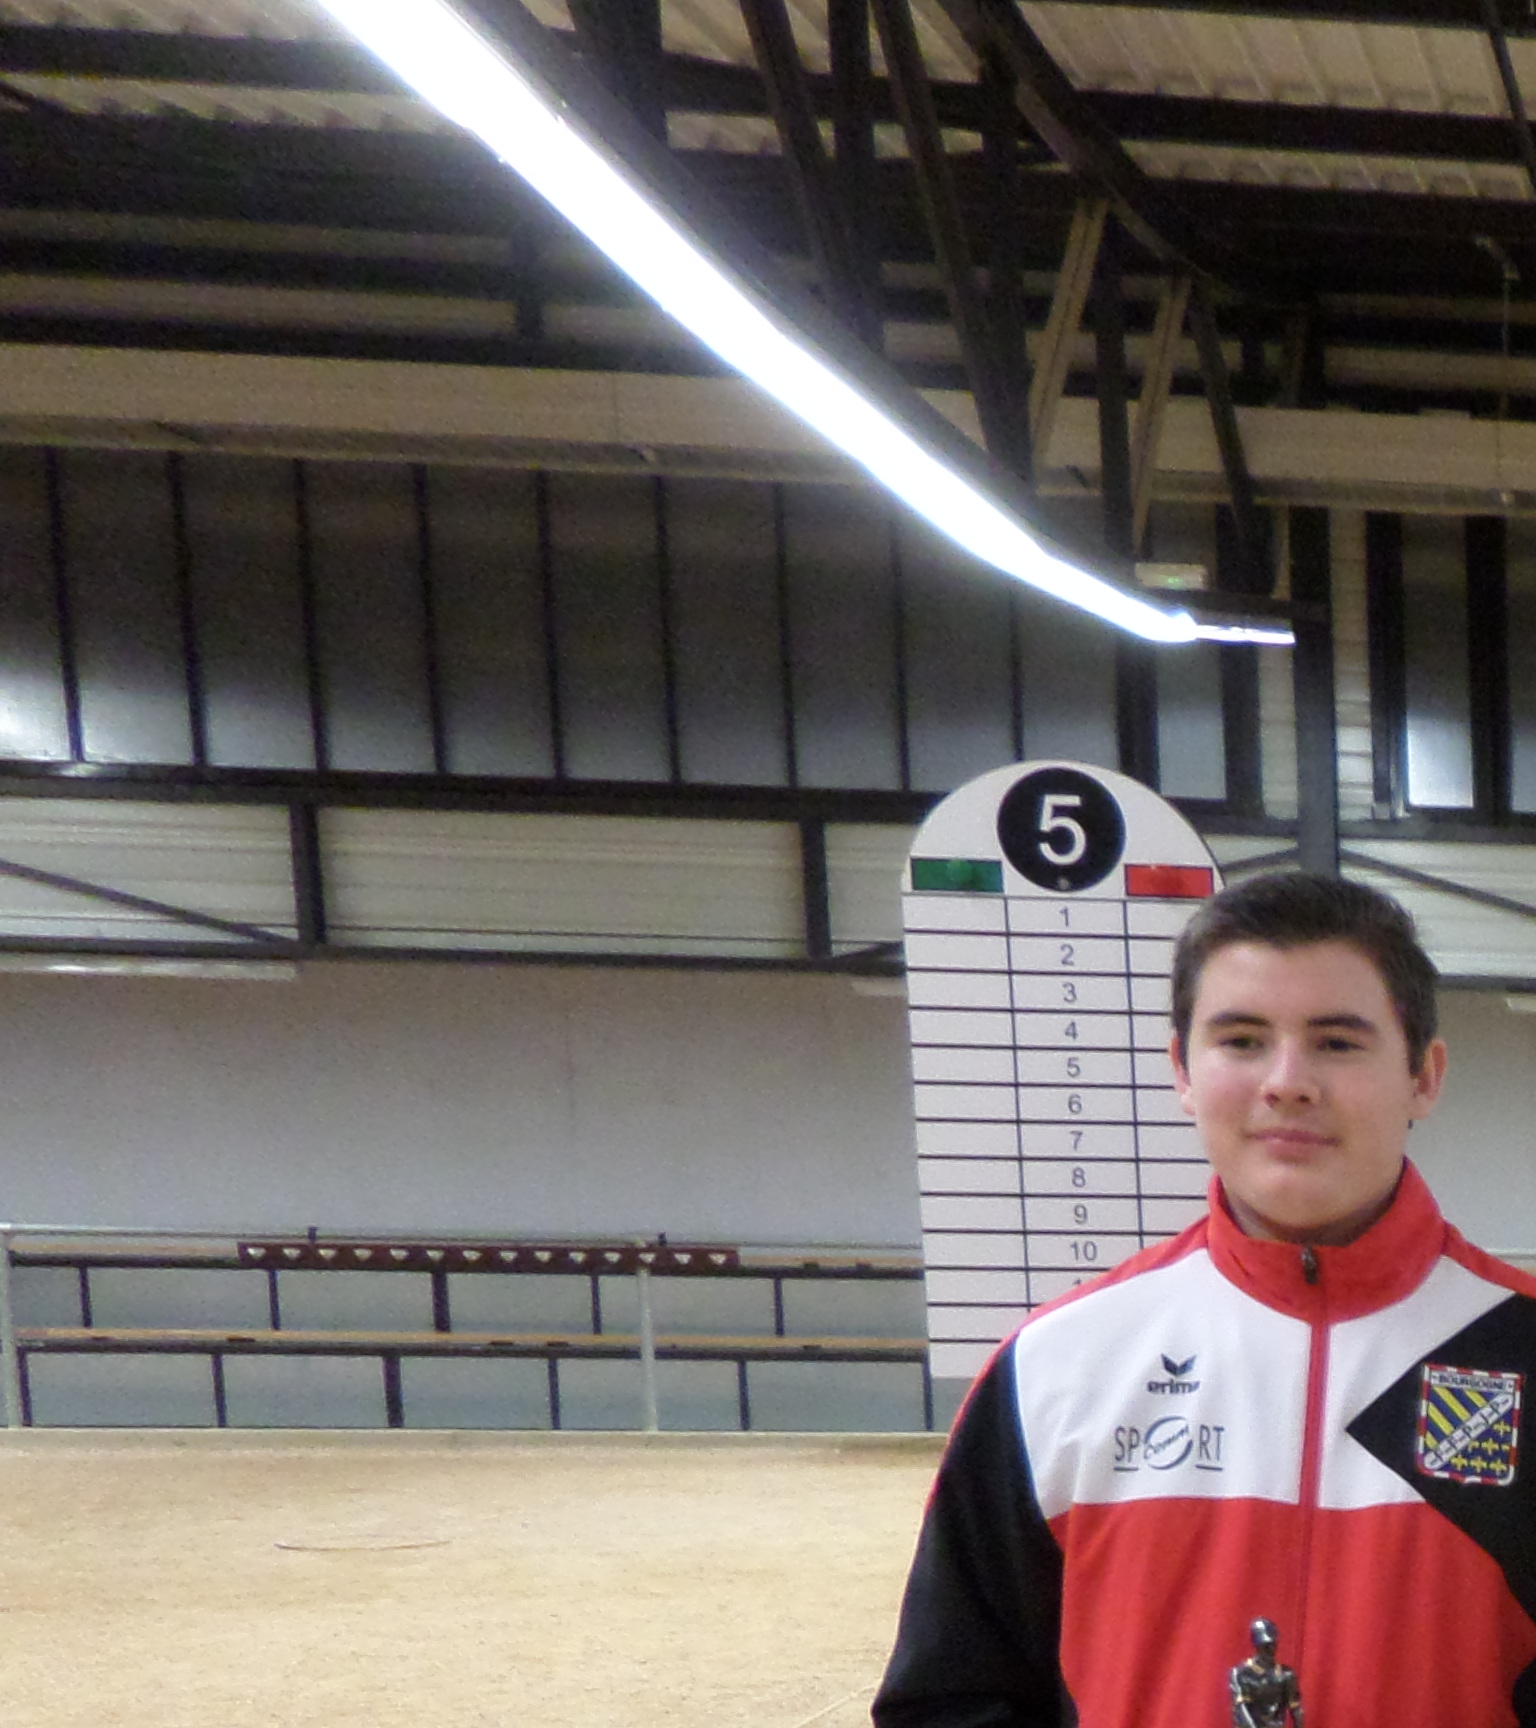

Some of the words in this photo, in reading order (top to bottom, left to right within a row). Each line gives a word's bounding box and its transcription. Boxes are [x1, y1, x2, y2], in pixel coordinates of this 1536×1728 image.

[1039, 793, 1086, 866] 5
[1059, 906, 1069, 928] 1
[1060, 943, 1076, 967] 2
[1061, 981, 1078, 1004] 3
[1064, 1020, 1079, 1041] 4
[1066, 1056, 1082, 1079] 5
[1067, 1093, 1083, 1115] 6
[1069, 1130, 1084, 1151] 7
[1071, 1166, 1087, 1189] 8
[1073, 1204, 1089, 1225] 9
[1069, 1240, 1098, 1262] 10
